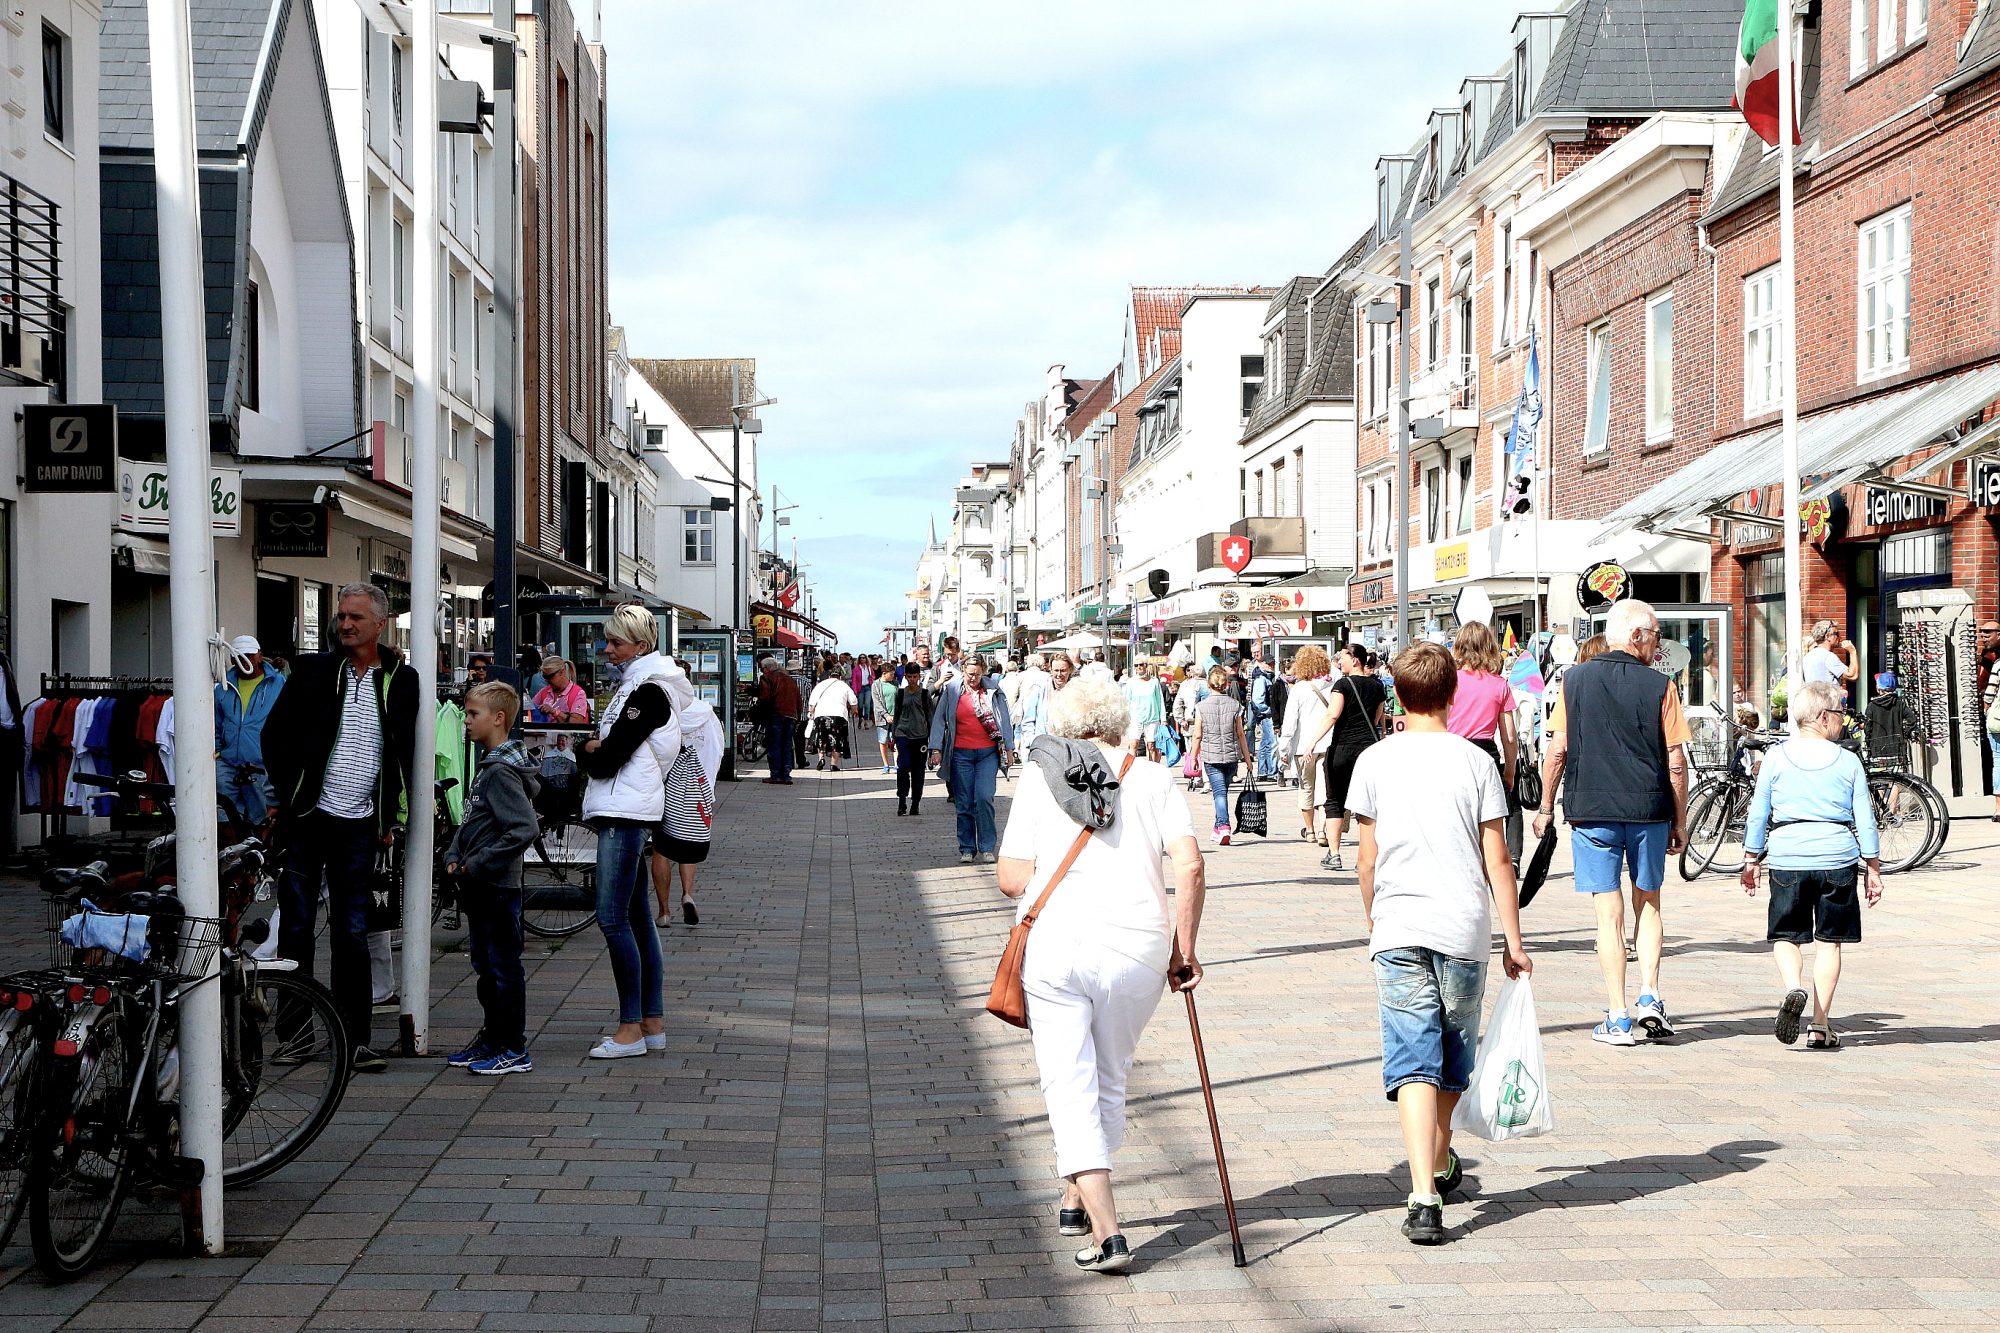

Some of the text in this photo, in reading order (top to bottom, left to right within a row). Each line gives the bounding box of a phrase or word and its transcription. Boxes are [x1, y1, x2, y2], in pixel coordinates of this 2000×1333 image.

[37, 465, 103, 481] CAMP DAVID
[138, 472, 237, 515] Trke
[1865, 486, 1935, 526] fielmann
[1017, 602, 1030, 610] sky
[1249, 598, 1282, 607] PIZZA
[1258, 623, 1281, 633] EIS
